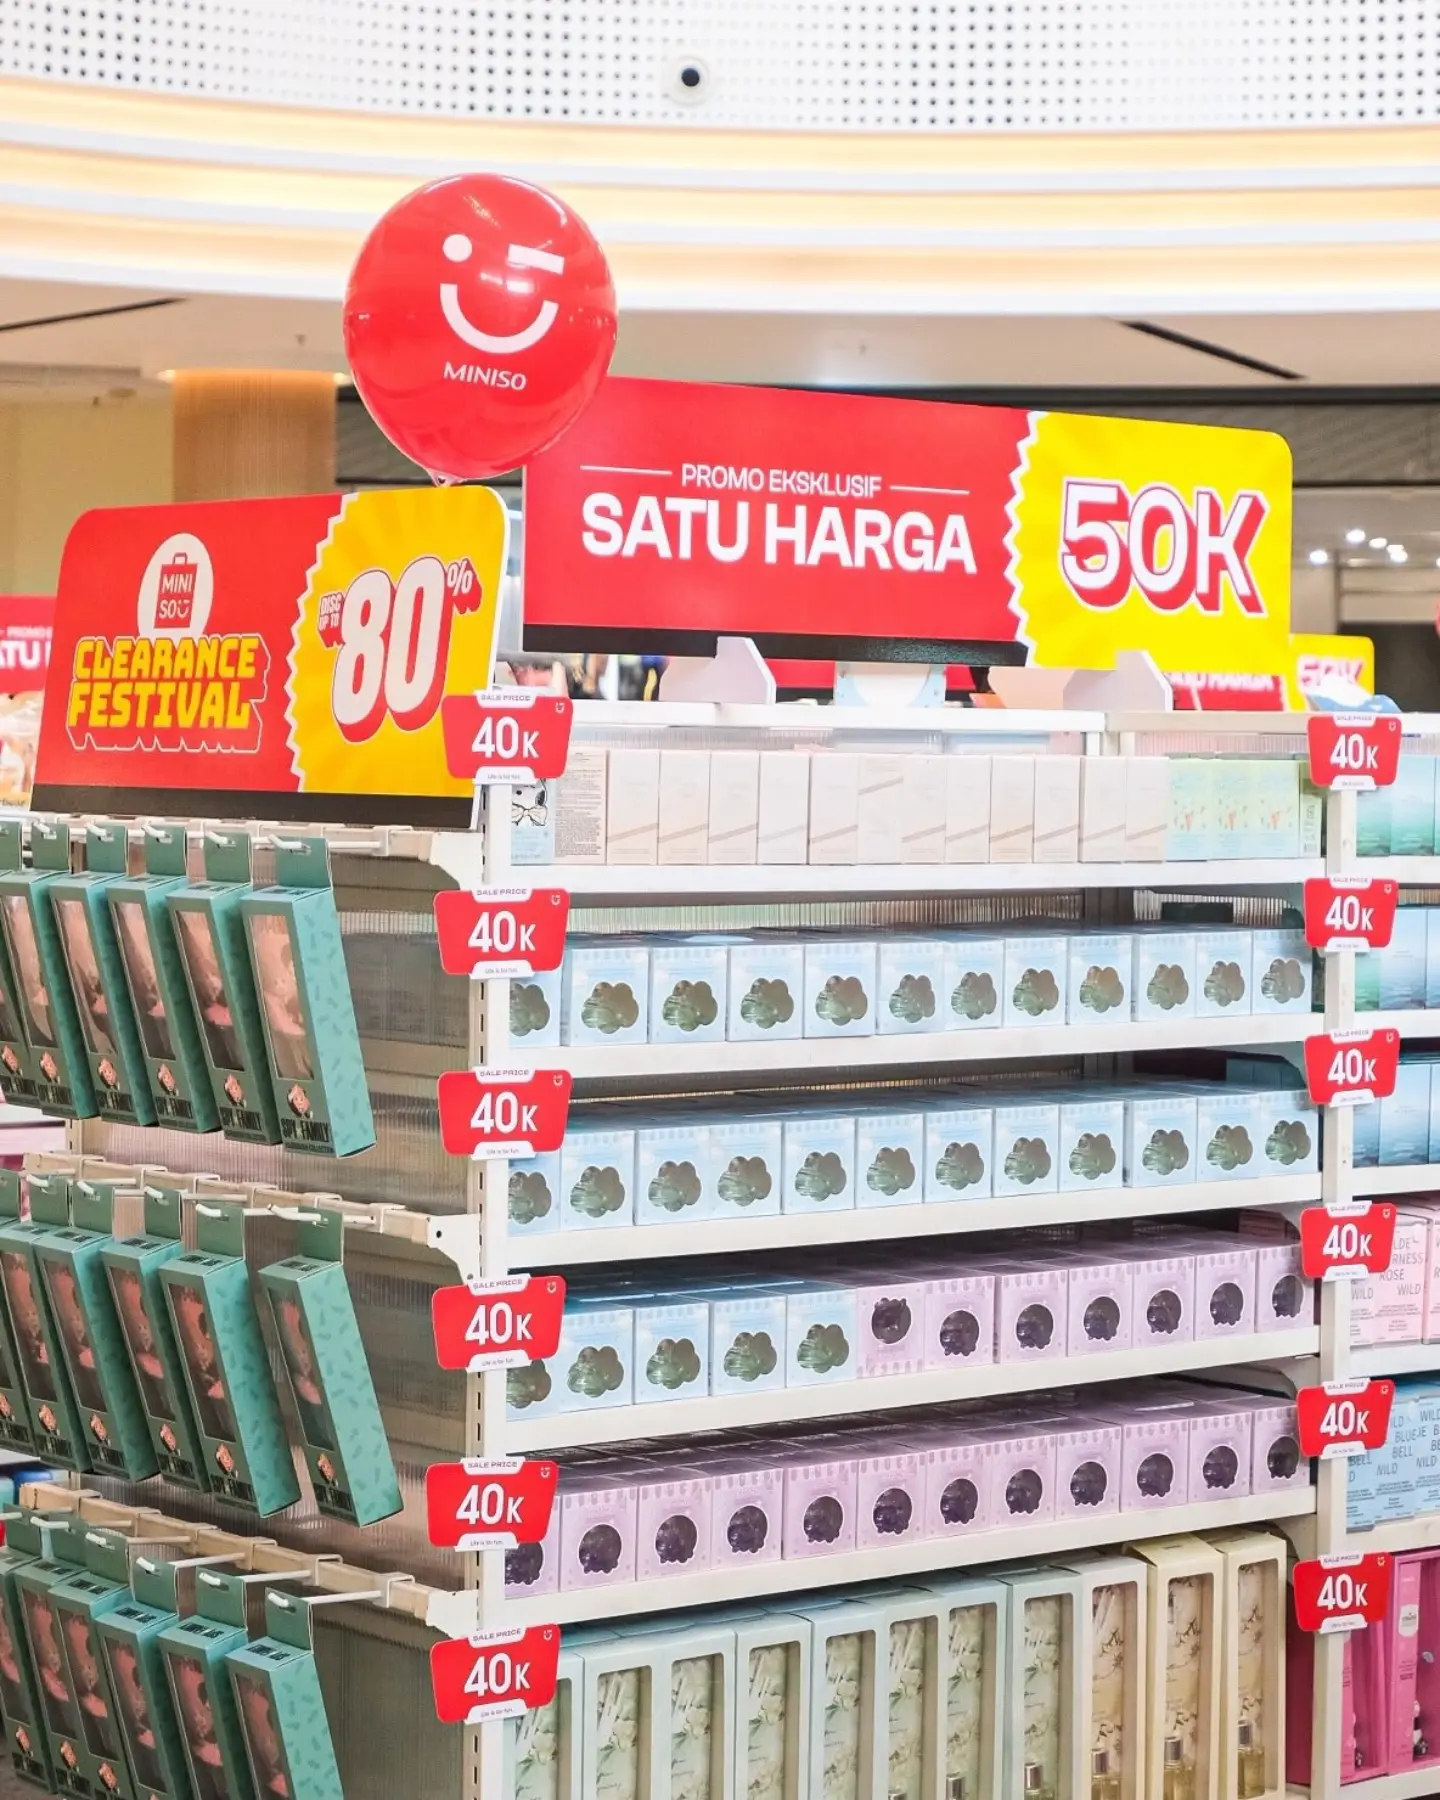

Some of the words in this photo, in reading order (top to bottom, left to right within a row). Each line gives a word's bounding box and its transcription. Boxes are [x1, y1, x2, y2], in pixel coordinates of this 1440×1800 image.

[443, 361, 526, 390] MINISO
[682, 463, 765, 491] PROMO
[769, 469, 882, 498] EKSKLUSIF
[582, 492, 750, 562] SATU
[764, 503, 977, 574] HARGA
[1061, 480, 1265, 614] 50K
[161, 573, 194, 594] MINI
[320, 592, 343, 615] DISC
[75, 634, 260, 679] CLEARANCE
[68, 681, 250, 729] FESTIVAL
[472, 716, 540, 759] 40K
[1330, 733, 1378, 769] 40K
[468, 910, 536, 953] 40K
[1324, 895, 1374, 931] 40K
[1328, 1048, 1378, 1085] 40K
[470, 1091, 538, 1134] 40K
[1322, 1223, 1372, 1260] 40K
[473, 1282, 495, 1290] SALE
[496, 1279, 523, 1287] PRICE
[1397, 1283, 1421, 1296] WILD
[464, 1302, 533, 1346] 40K
[1320, 1400, 1370, 1437] 40K
[1392, 1446, 1413, 1459] BELL
[456, 1482, 524, 1525] 40K
[1316, 1574, 1368, 1610] 40K
[472, 1634, 495, 1642] SALE
[496, 1628, 521, 1638] PRICE
[464, 1652, 531, 1697] 40K
